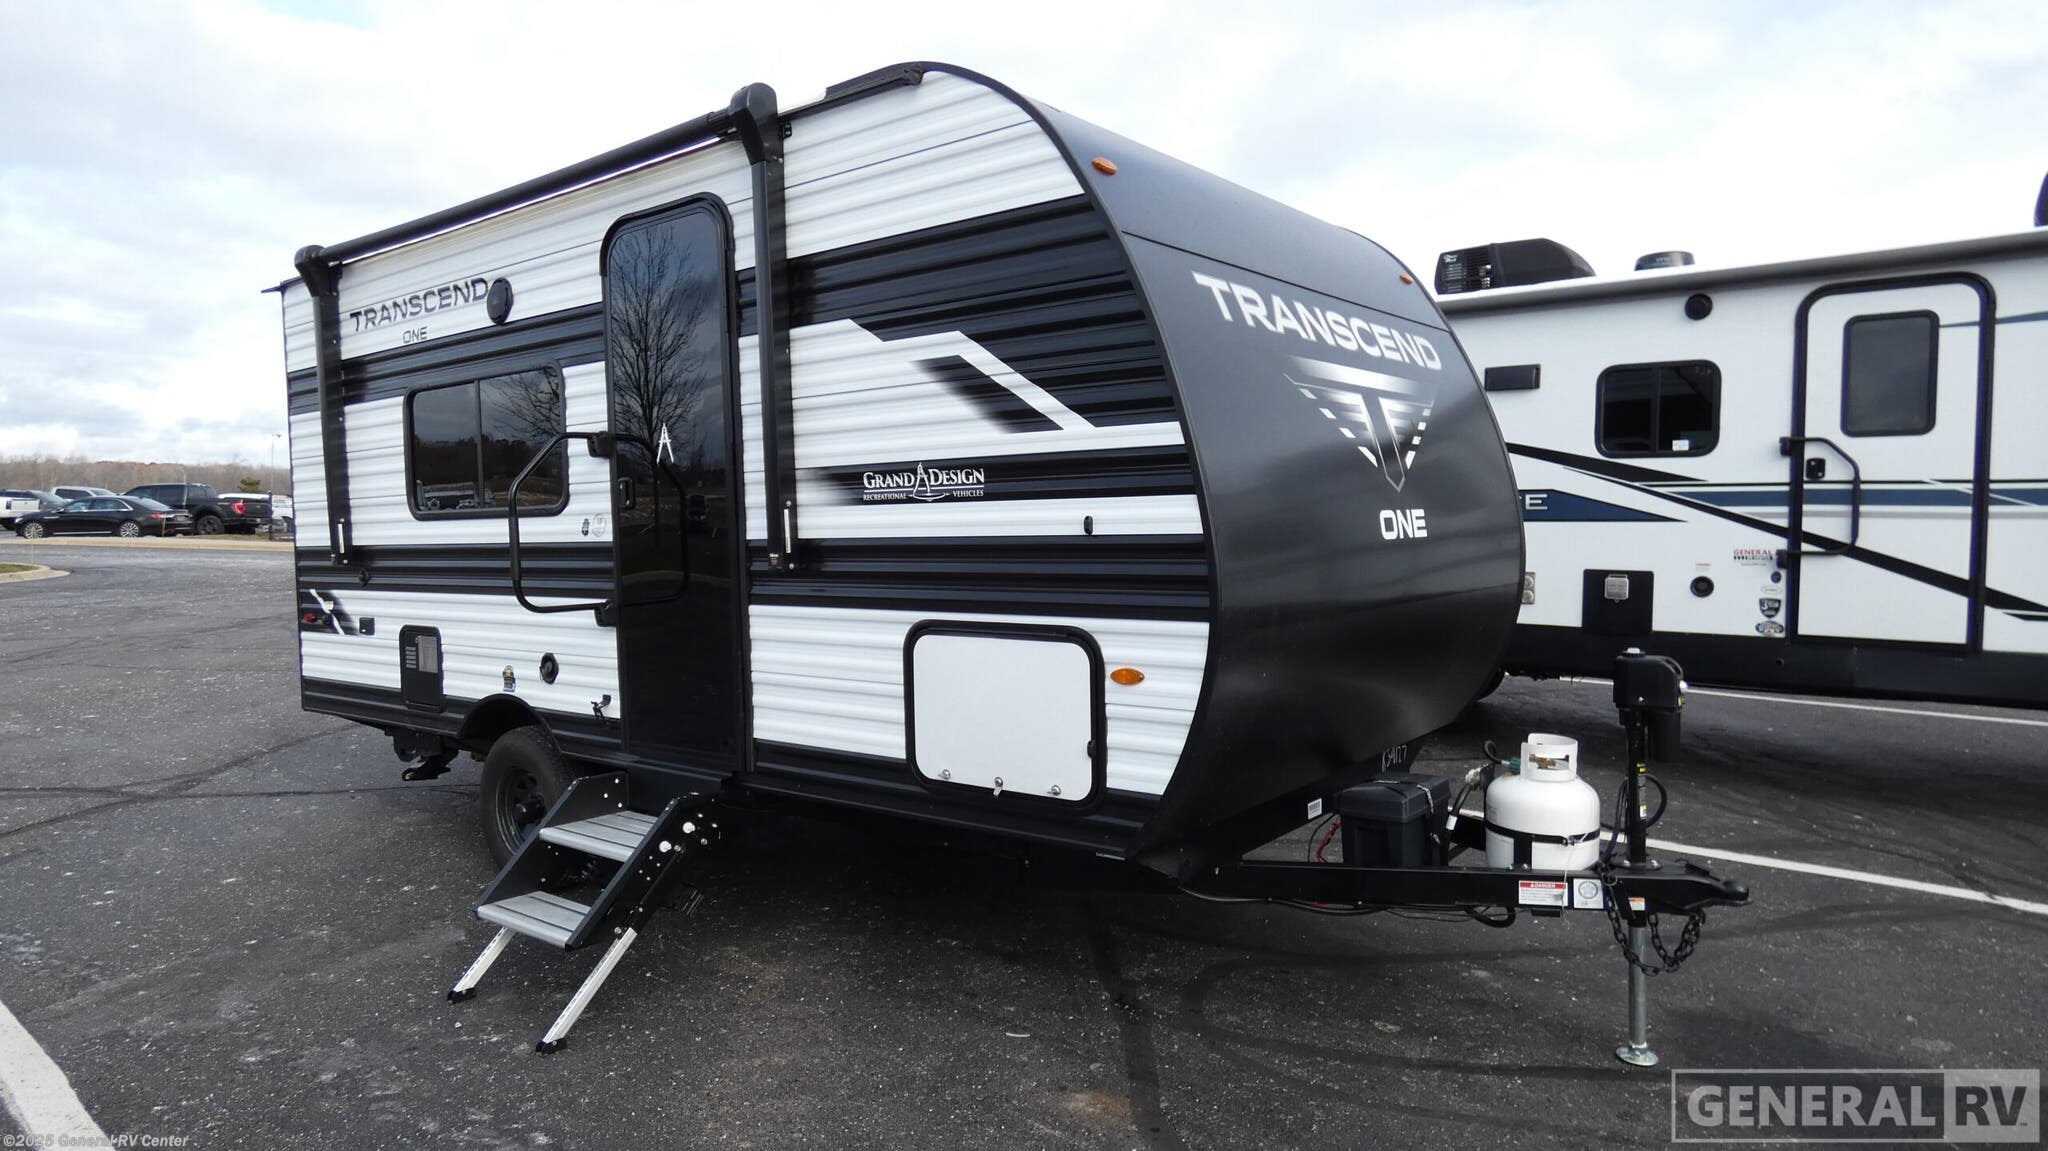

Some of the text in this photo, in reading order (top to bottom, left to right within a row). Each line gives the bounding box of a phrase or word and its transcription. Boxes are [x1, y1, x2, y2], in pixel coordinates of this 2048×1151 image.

[350, 277, 489, 332] TRANSCEND
[1191, 271, 1442, 371] TRANSCEND
[402, 326, 428, 345] ONE
[863, 468, 985, 489] GRAND DESIGN
[863, 489, 984, 501] RECREATIONAL VEHICLES
[1379, 508, 1428, 540] ONE
